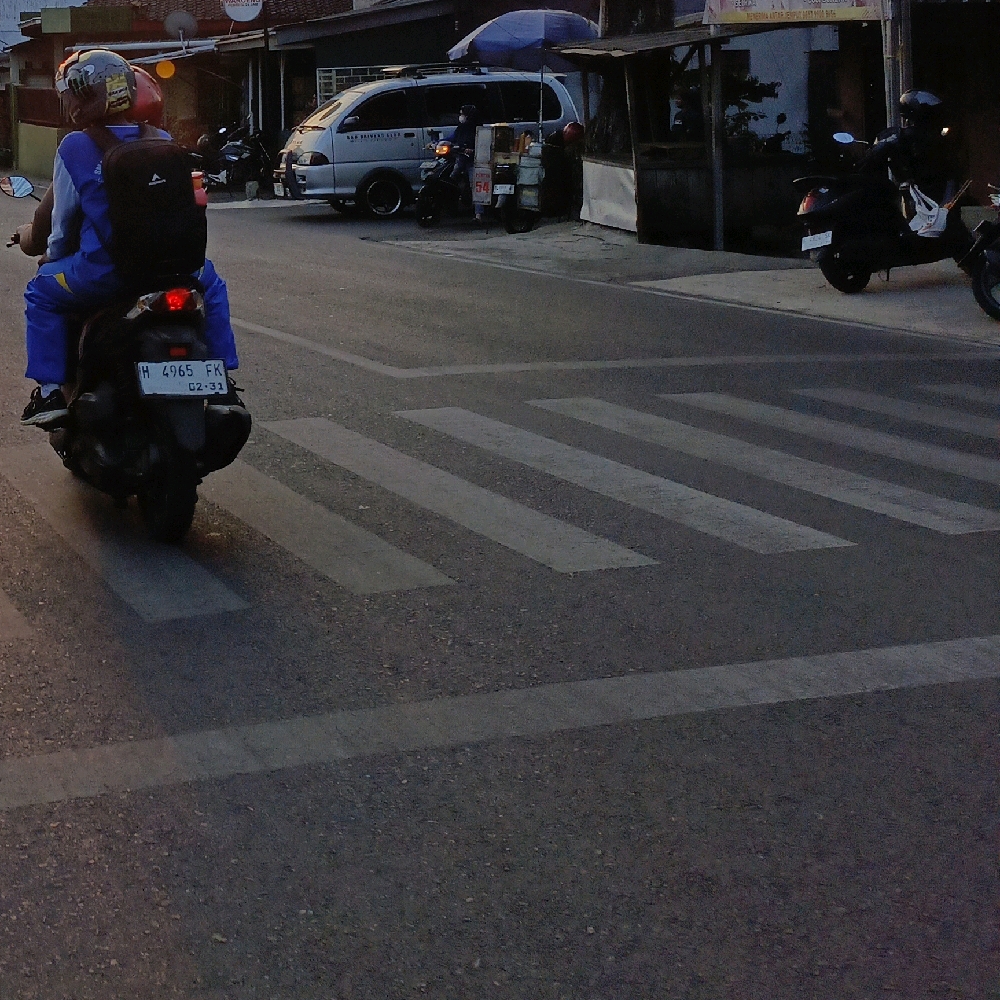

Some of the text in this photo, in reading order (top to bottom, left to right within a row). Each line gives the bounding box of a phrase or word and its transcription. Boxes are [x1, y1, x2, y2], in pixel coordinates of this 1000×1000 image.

[475, 181, 489, 194] 54
[141, 363, 223, 379] H 4965 FK
